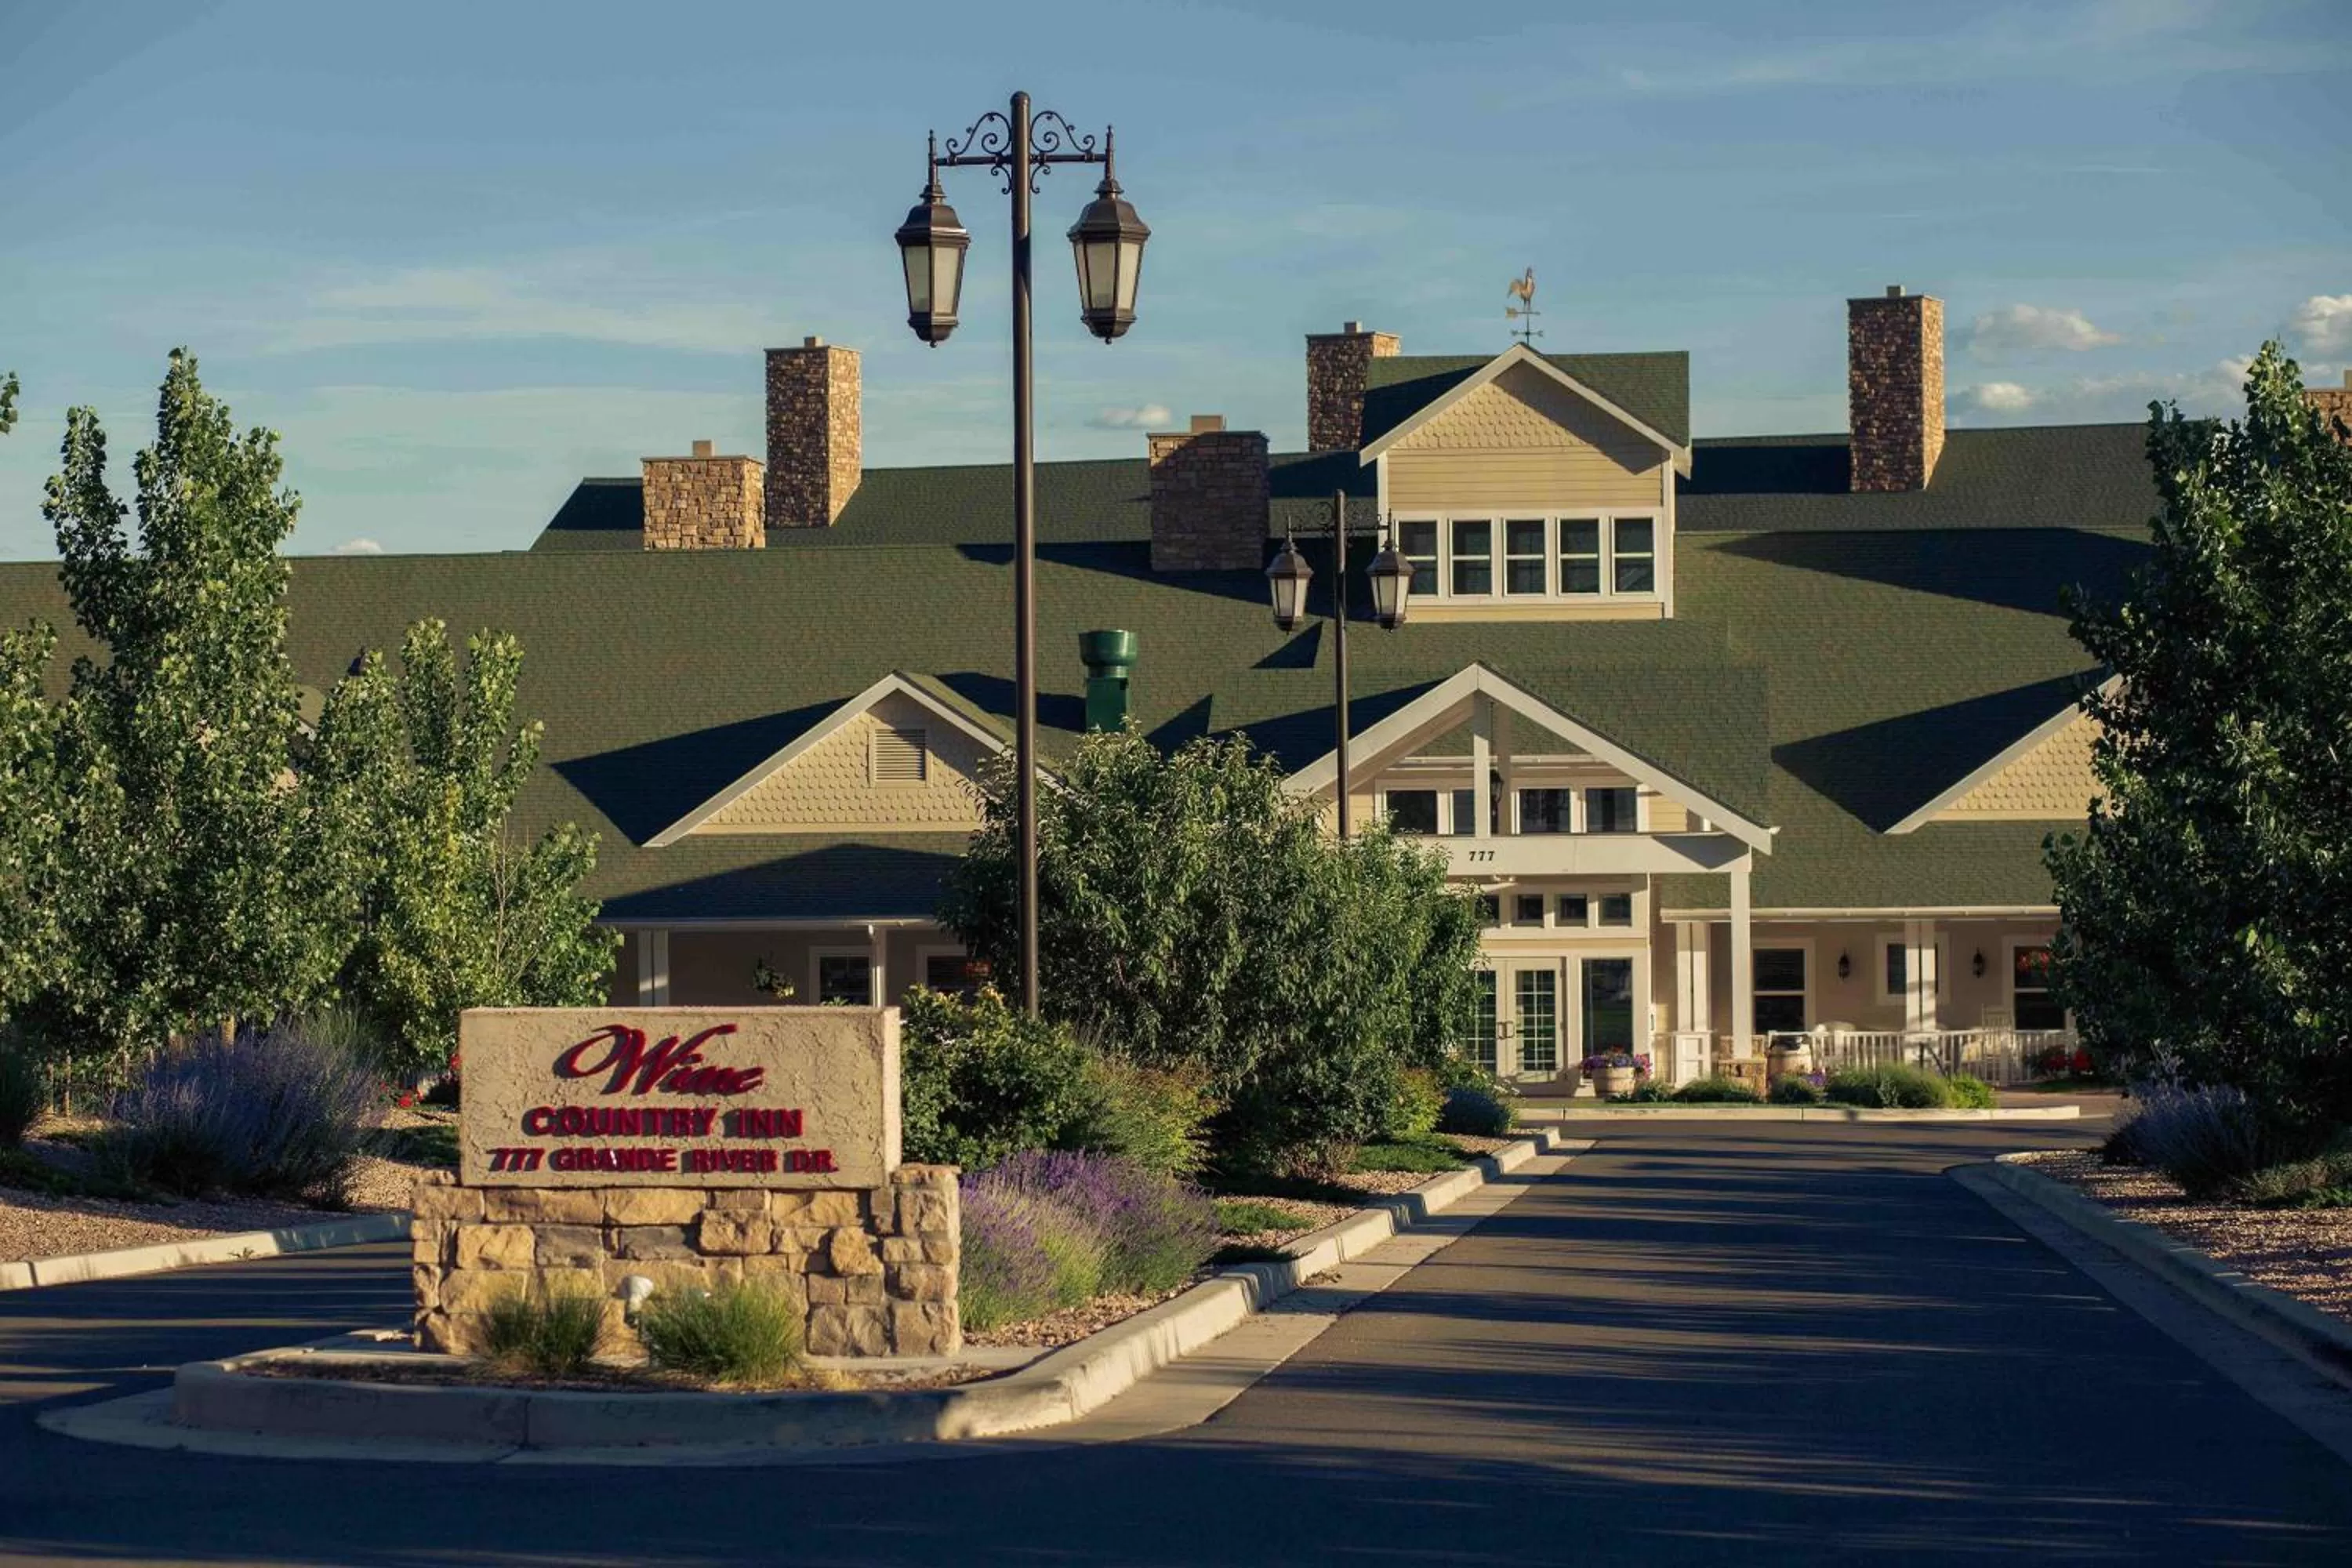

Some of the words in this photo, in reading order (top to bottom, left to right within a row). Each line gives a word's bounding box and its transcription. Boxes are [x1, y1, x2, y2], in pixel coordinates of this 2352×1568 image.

[1468, 851, 1495, 862] 777
[554, 1024, 764, 1095] Wine
[527, 1106, 718, 1137] COUNTRY
[731, 1108, 803, 1138] INN
[491, 1148, 545, 1171] 777
[552, 1147, 677, 1172] GRANDE
[687, 1149, 778, 1173] RIVER
[787, 1149, 840, 1173] DR.
